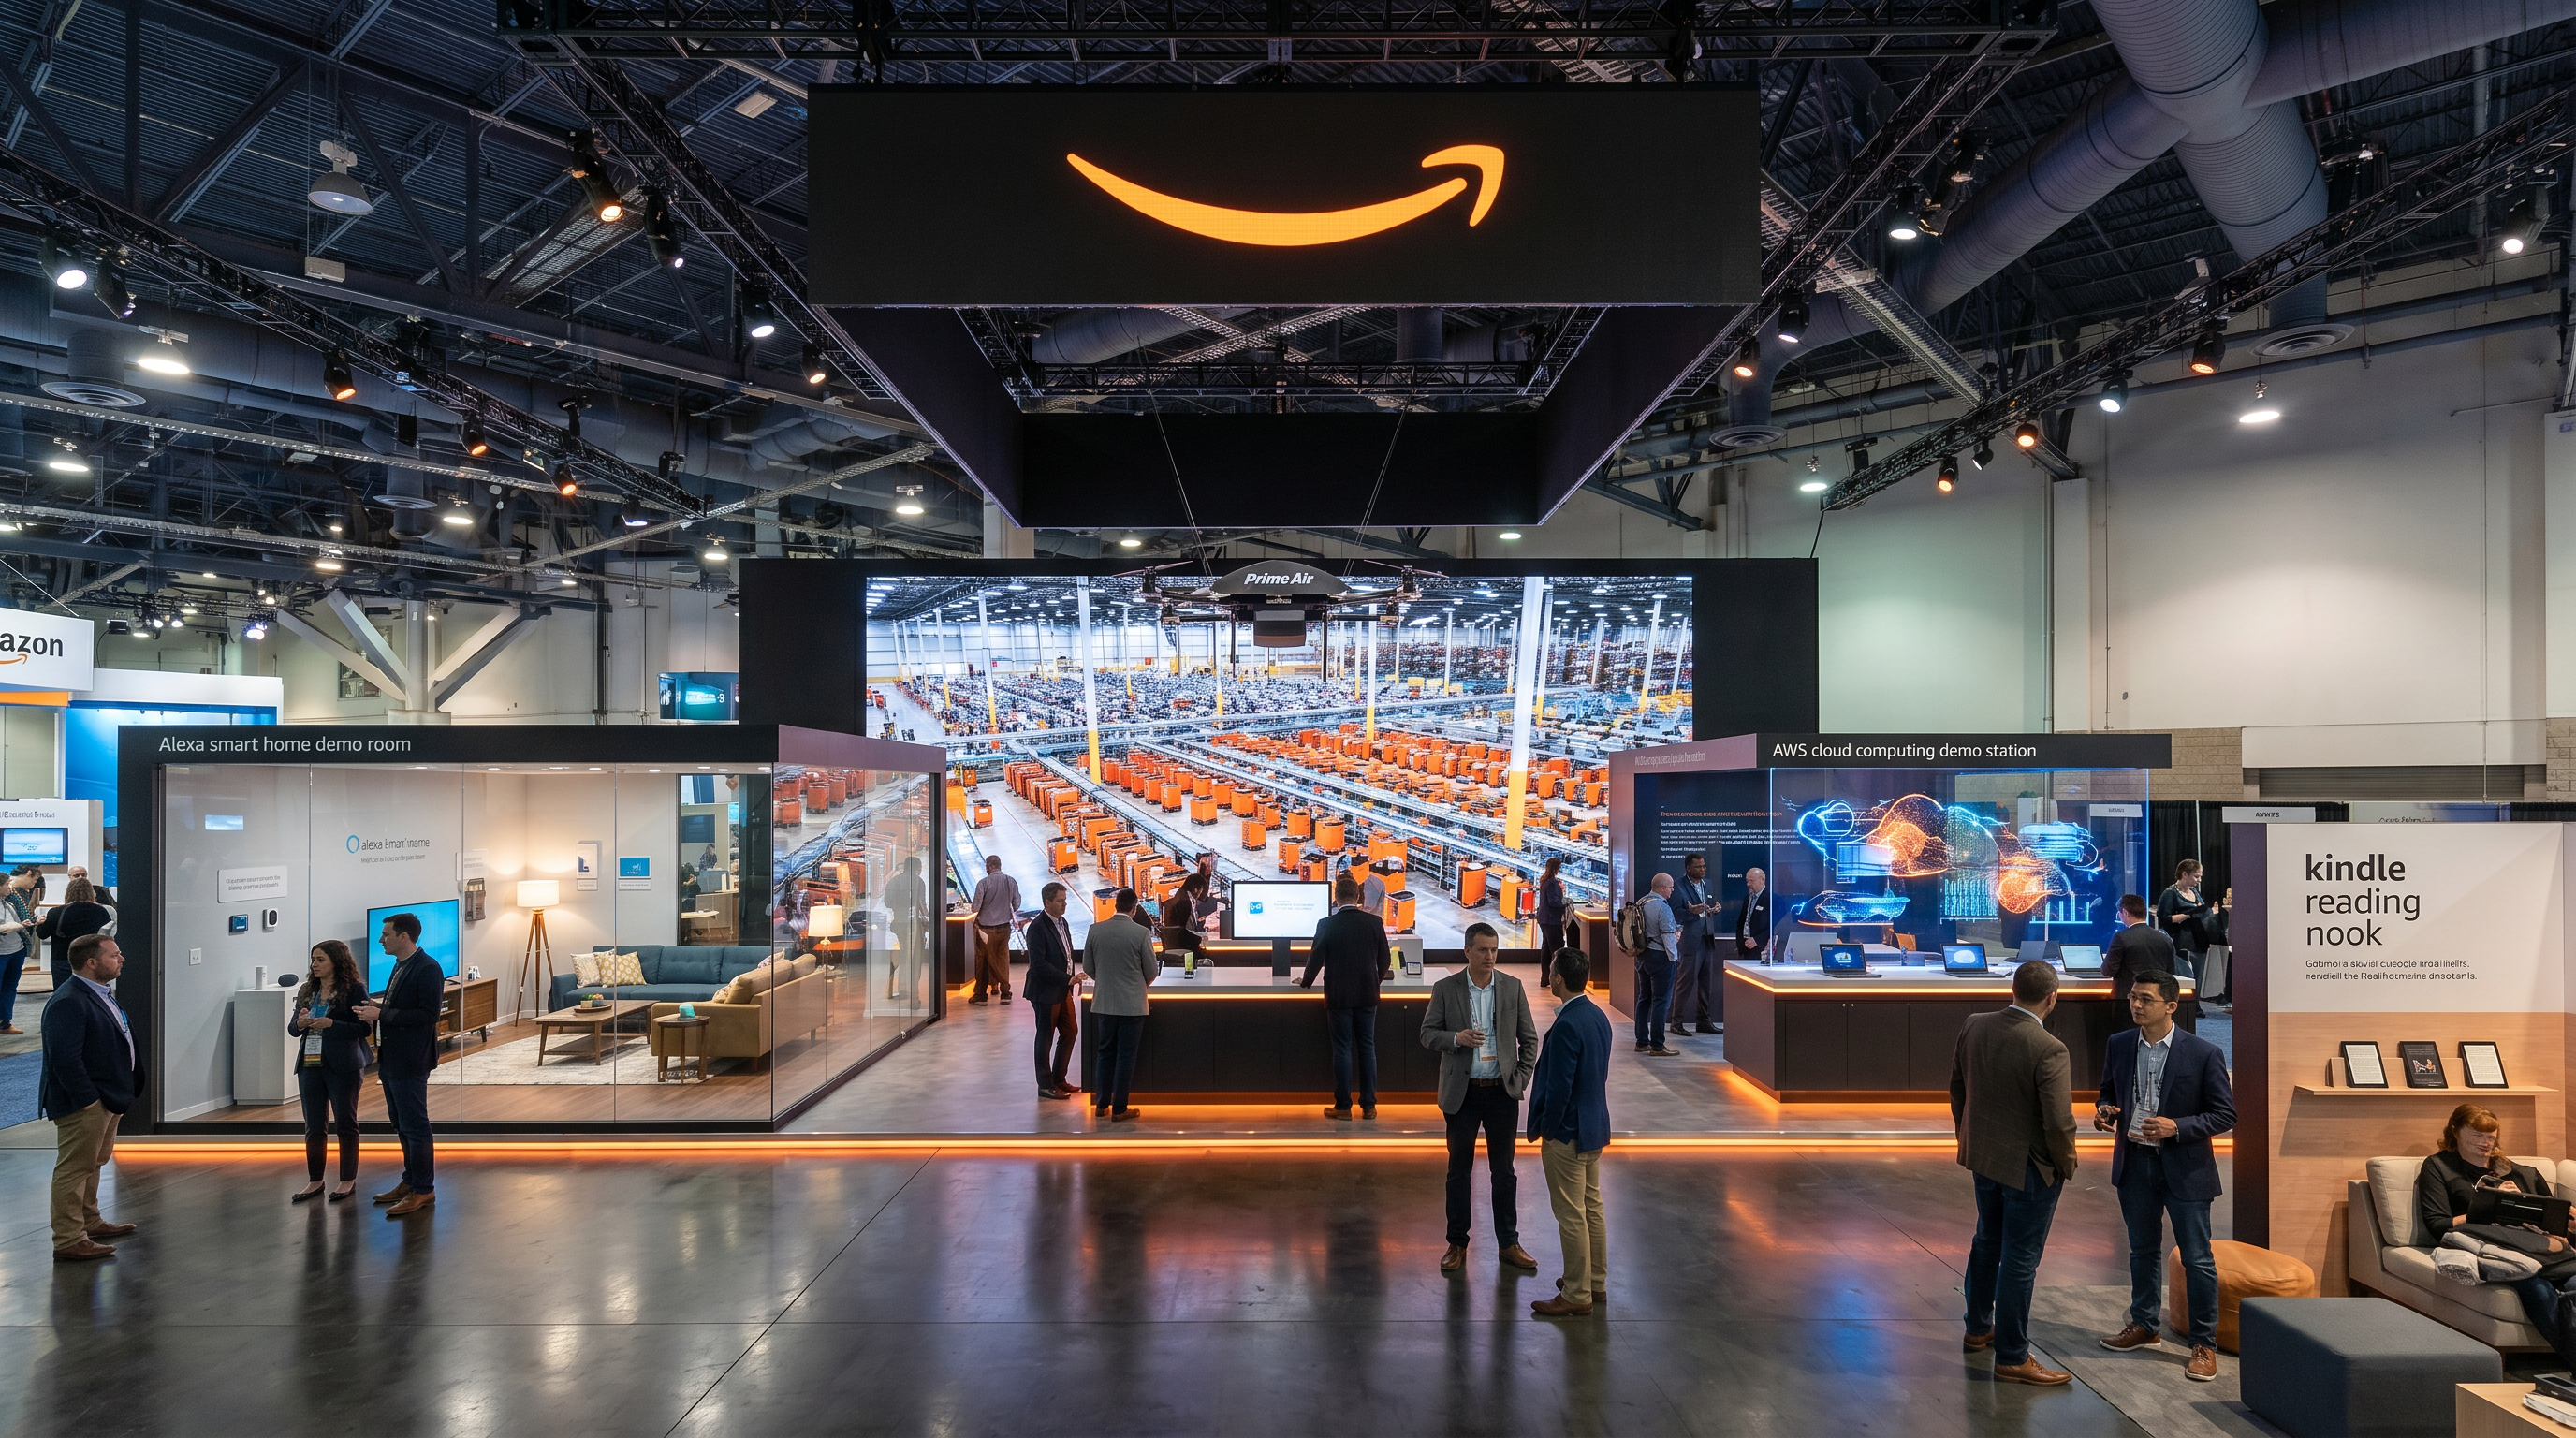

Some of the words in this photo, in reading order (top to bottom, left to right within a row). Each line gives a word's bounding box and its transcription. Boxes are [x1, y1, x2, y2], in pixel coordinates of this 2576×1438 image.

[1244, 572, 1290, 585] Prime
[1290, 572, 1314, 585] Air
[158, 736, 204, 752] Alexa
[210, 738, 258, 752] smart
[264, 736, 311, 752] home
[315, 736, 362, 752] demo
[368, 739, 411, 752] room
[1772, 743, 1808, 757] AWS
[1811, 742, 1852, 757] cloud
[1855, 743, 1935, 760] computing
[1939, 742, 1982, 757] demo
[1985, 743, 2037, 757] station
[361, 839, 383, 851] alexa
[2305, 853, 2406, 882] kindle
[2306, 887, 2421, 921] reading
[2307, 918, 2383, 946] nook
[2344, 972, 2358, 980] the
